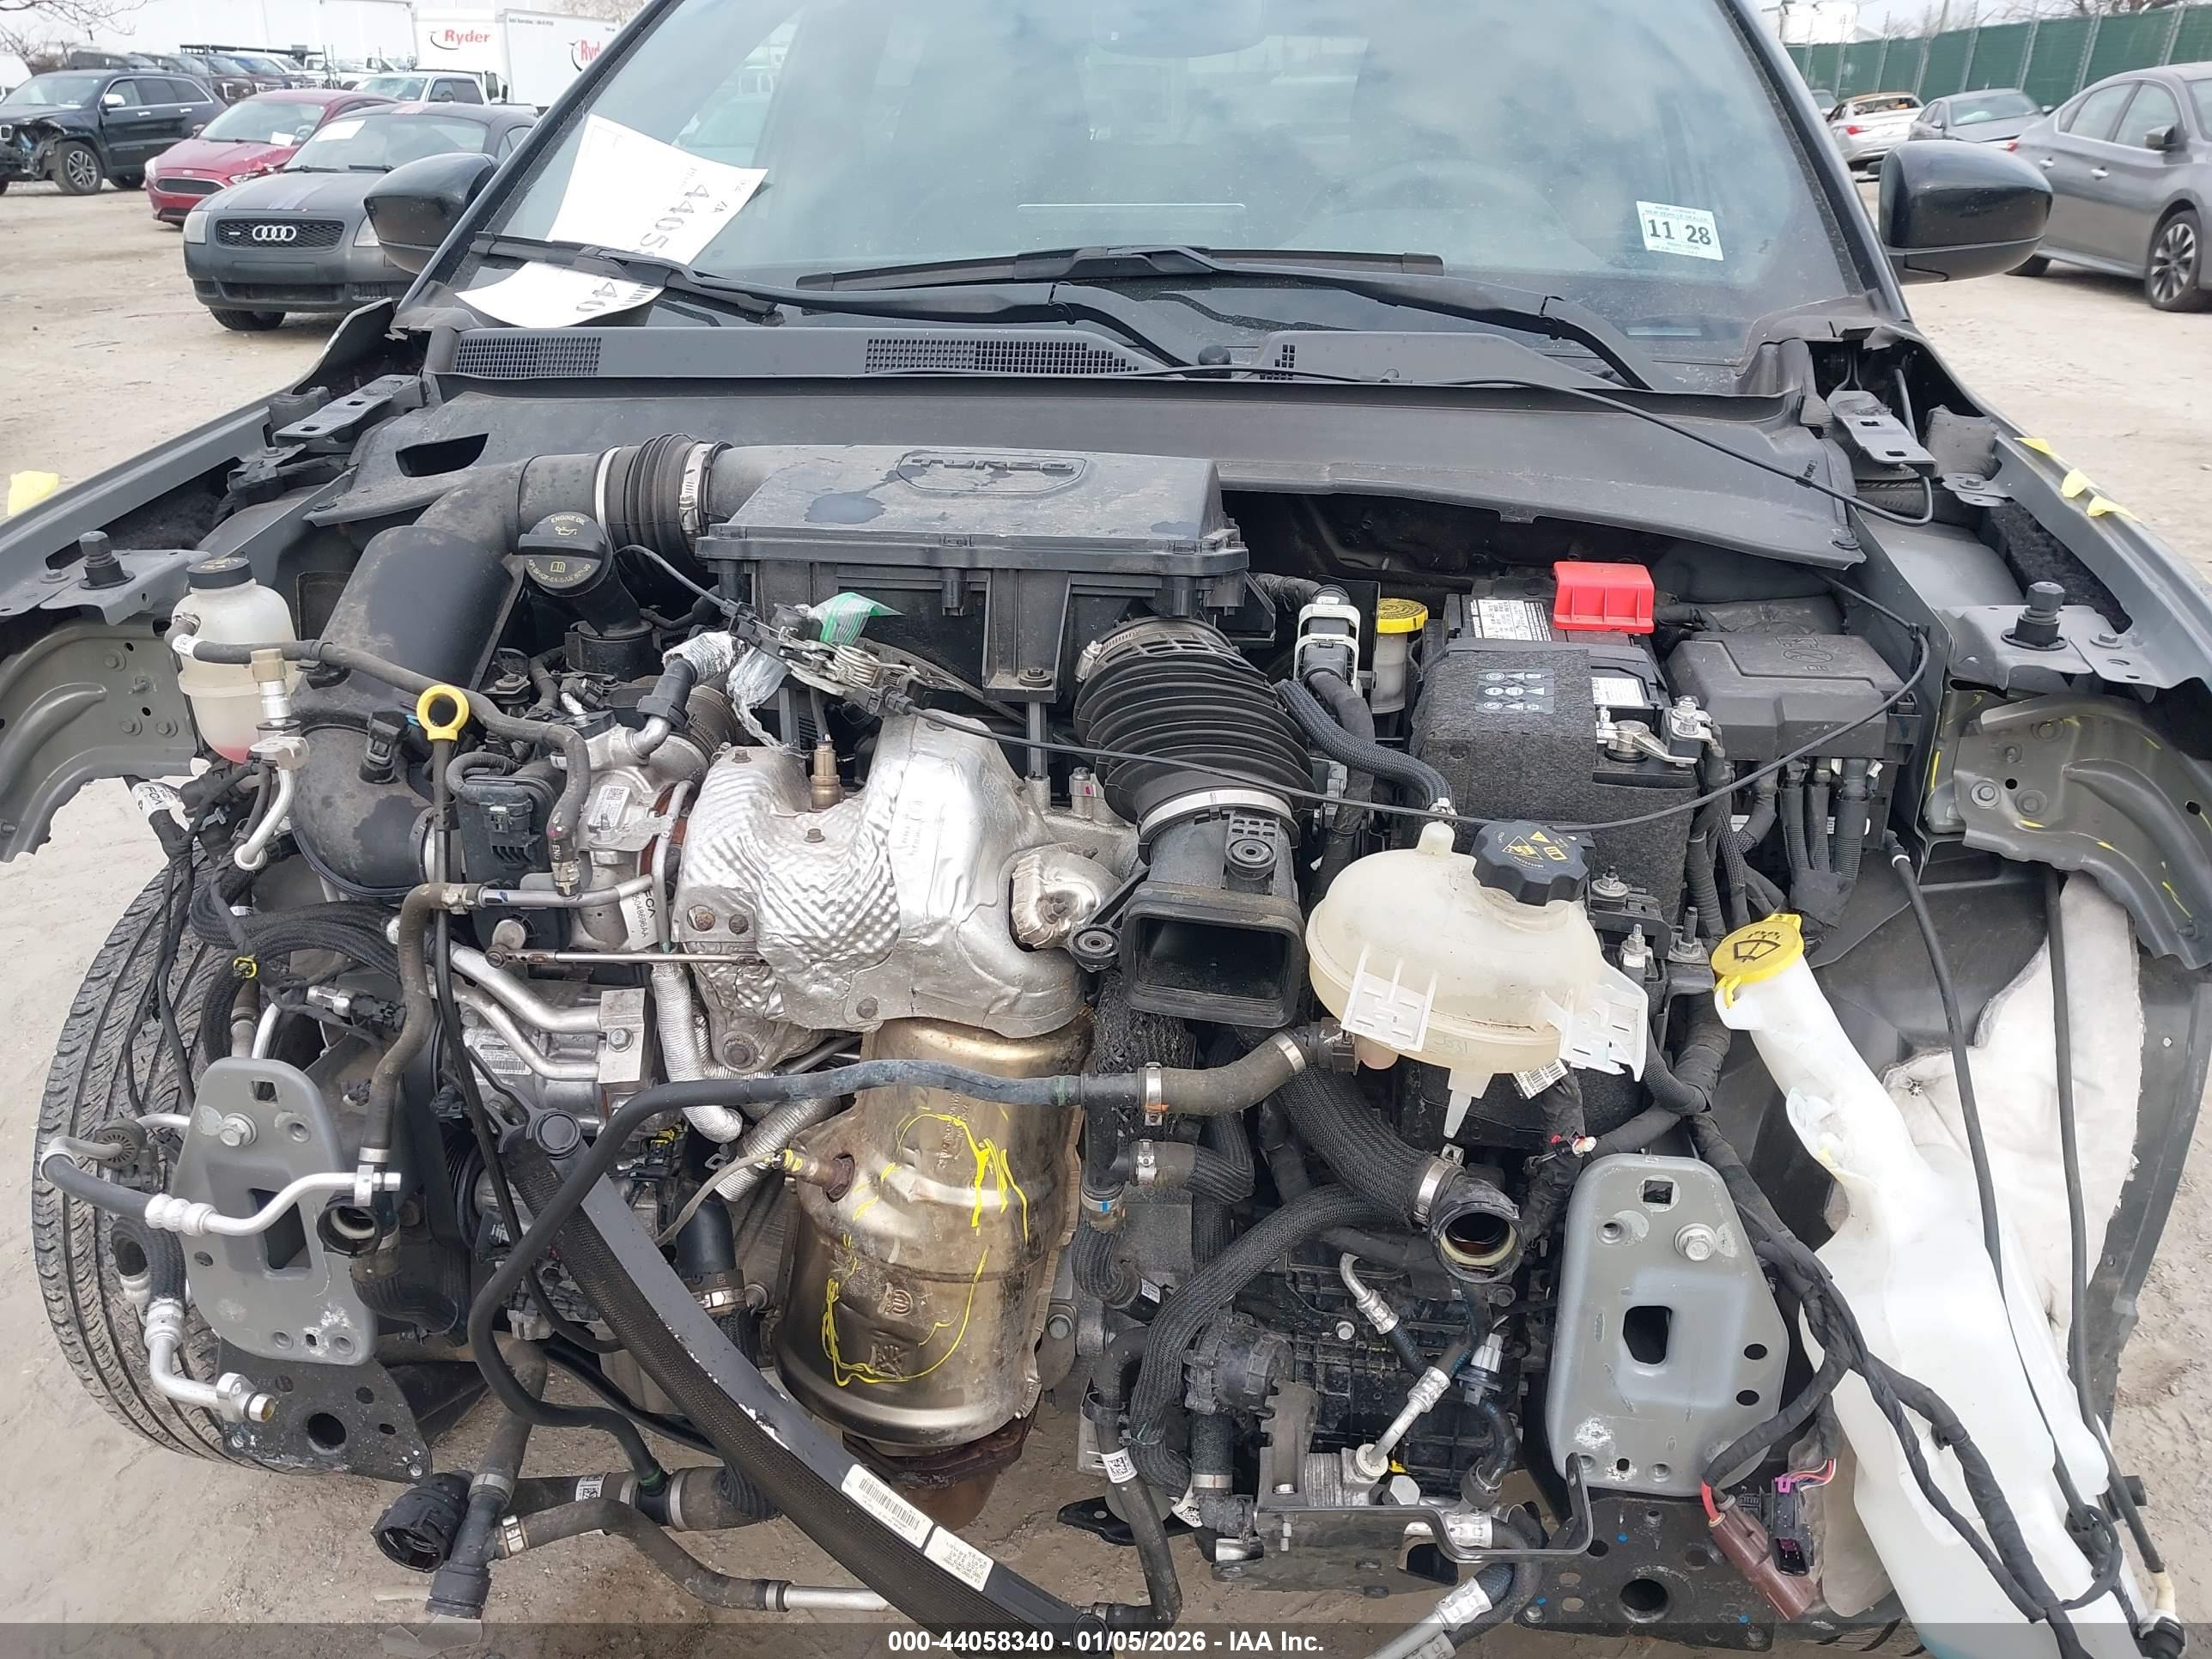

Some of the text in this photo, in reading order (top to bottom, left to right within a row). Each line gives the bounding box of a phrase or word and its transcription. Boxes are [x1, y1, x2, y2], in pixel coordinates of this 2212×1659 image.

[444, 29, 491, 46] Ryder
[580, 40, 600, 62] Ryd
[1648, 219, 1675, 240] 11
[1685, 224, 1711, 246] 28
[552, 844, 562, 860] ENG
